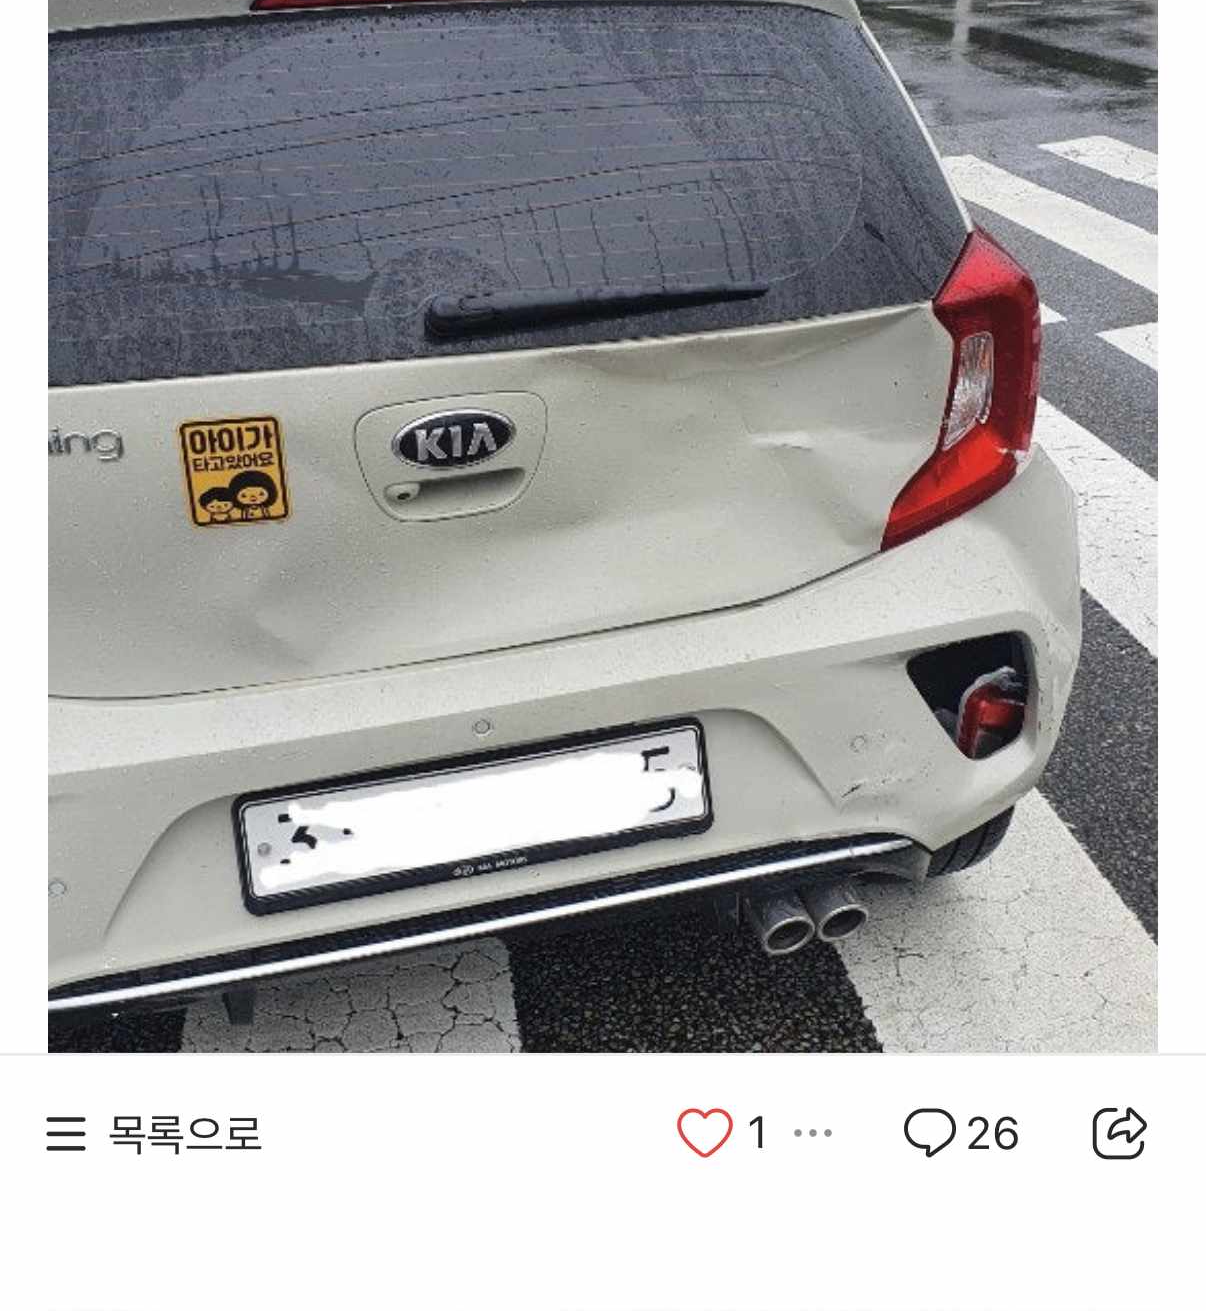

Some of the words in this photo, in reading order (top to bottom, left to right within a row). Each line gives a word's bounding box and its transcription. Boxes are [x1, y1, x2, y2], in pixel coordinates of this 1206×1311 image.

[48, 427, 124, 462] ing
[189, 424, 273, 454] 아이가
[415, 422, 497, 461] KIA
[192, 452, 275, 472] 타고있어요
[109, 1116, 262, 1155] 목록으로
[749, 1116, 764, 1149] 1
[967, 1116, 1019, 1150] 26
